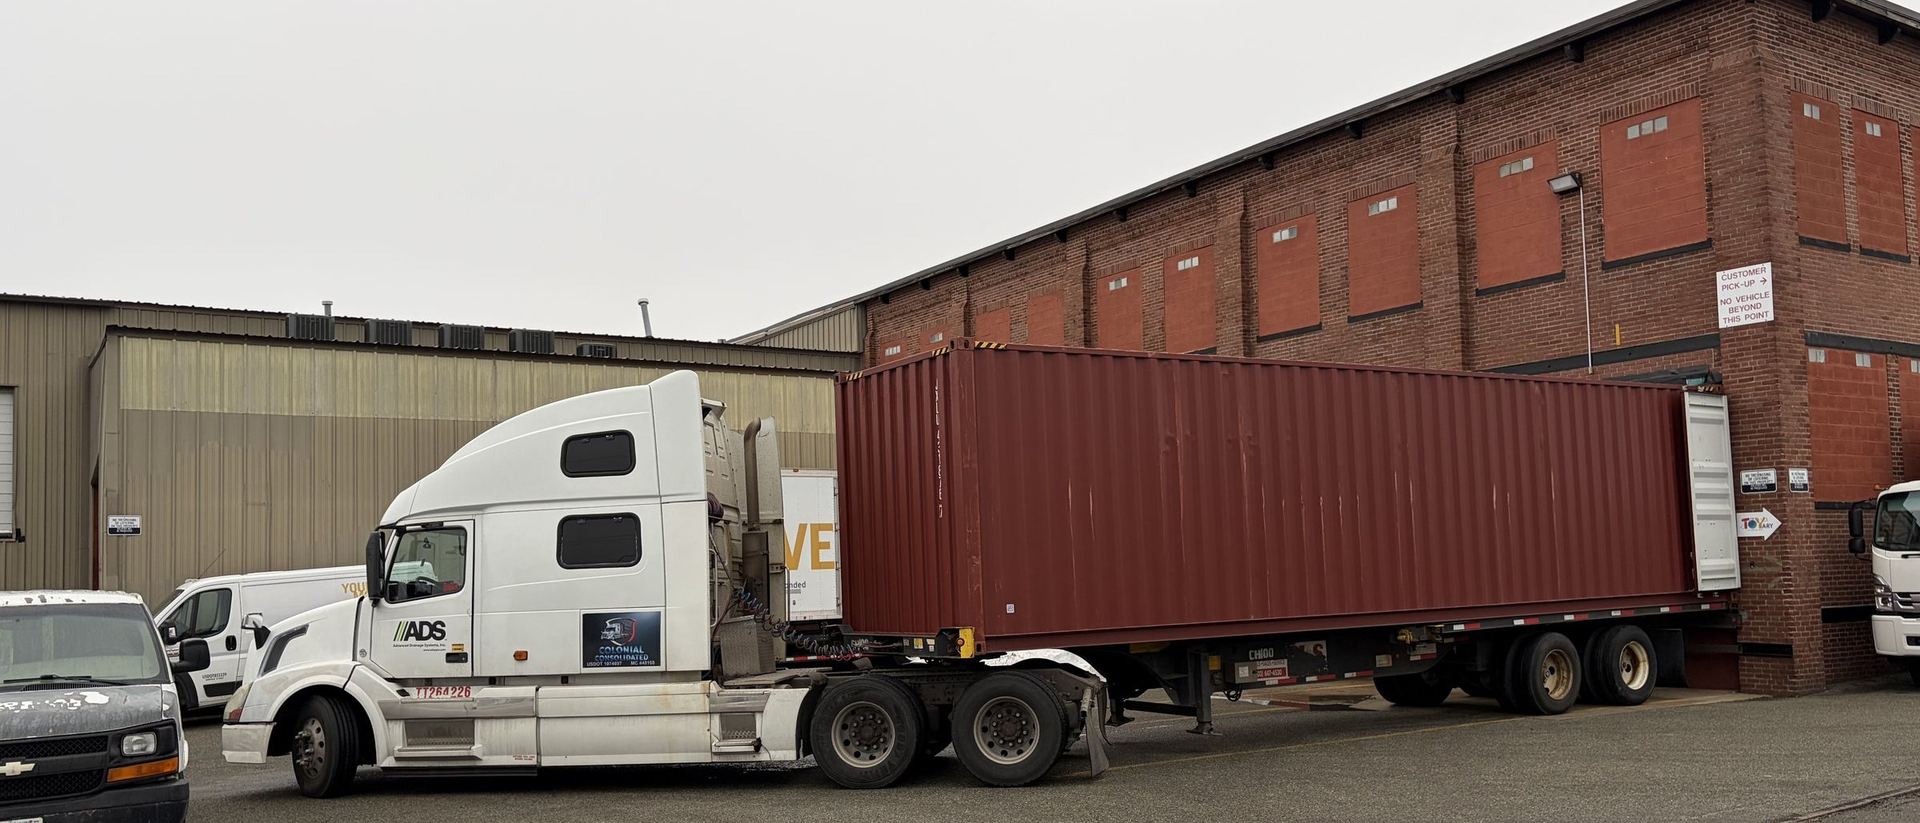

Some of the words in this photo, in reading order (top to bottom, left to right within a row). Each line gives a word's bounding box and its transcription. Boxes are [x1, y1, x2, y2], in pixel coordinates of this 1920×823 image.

[1721, 267, 1767, 281] CUSTOMER
[1721, 279, 1755, 291] PICK-UP
[1720, 298, 1732, 306] NO
[1735, 291, 1770, 303] VEHICLE
[1728, 302, 1762, 314] BEYOND
[1723, 316, 1741, 325] THIS
[1744, 311, 1769, 321] POINT
[341, 582, 368, 594] YOU
[404, 620, 446, 641] ADS
[599, 645, 645, 655] COLONIAL
[594, 654, 649, 662] CONSOLIDATED
